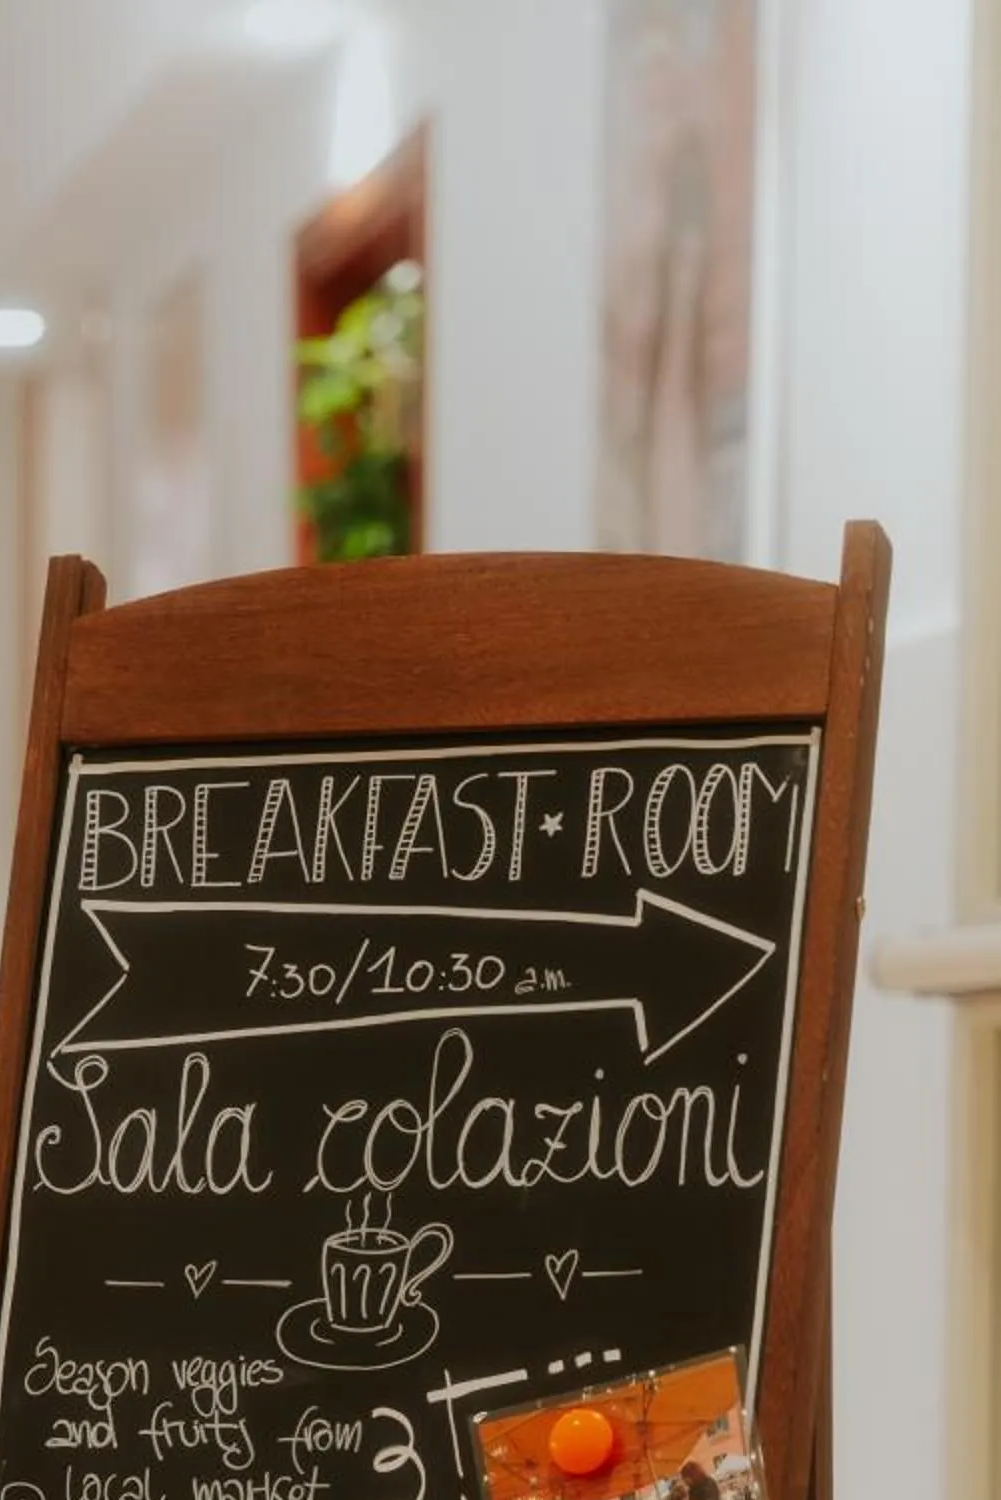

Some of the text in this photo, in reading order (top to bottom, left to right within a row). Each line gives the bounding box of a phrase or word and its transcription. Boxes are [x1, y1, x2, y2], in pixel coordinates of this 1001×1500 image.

[78, 762, 799, 891] BREAKFAST ROOM
[244, 938, 506, 1005] 7:30/10:30
[34, 1028, 767, 1194] Sala colazioni
[24, 1335, 285, 1417] Season veggies
[44, 1403, 118, 1450] and
[277, 1405, 363, 1475] from
